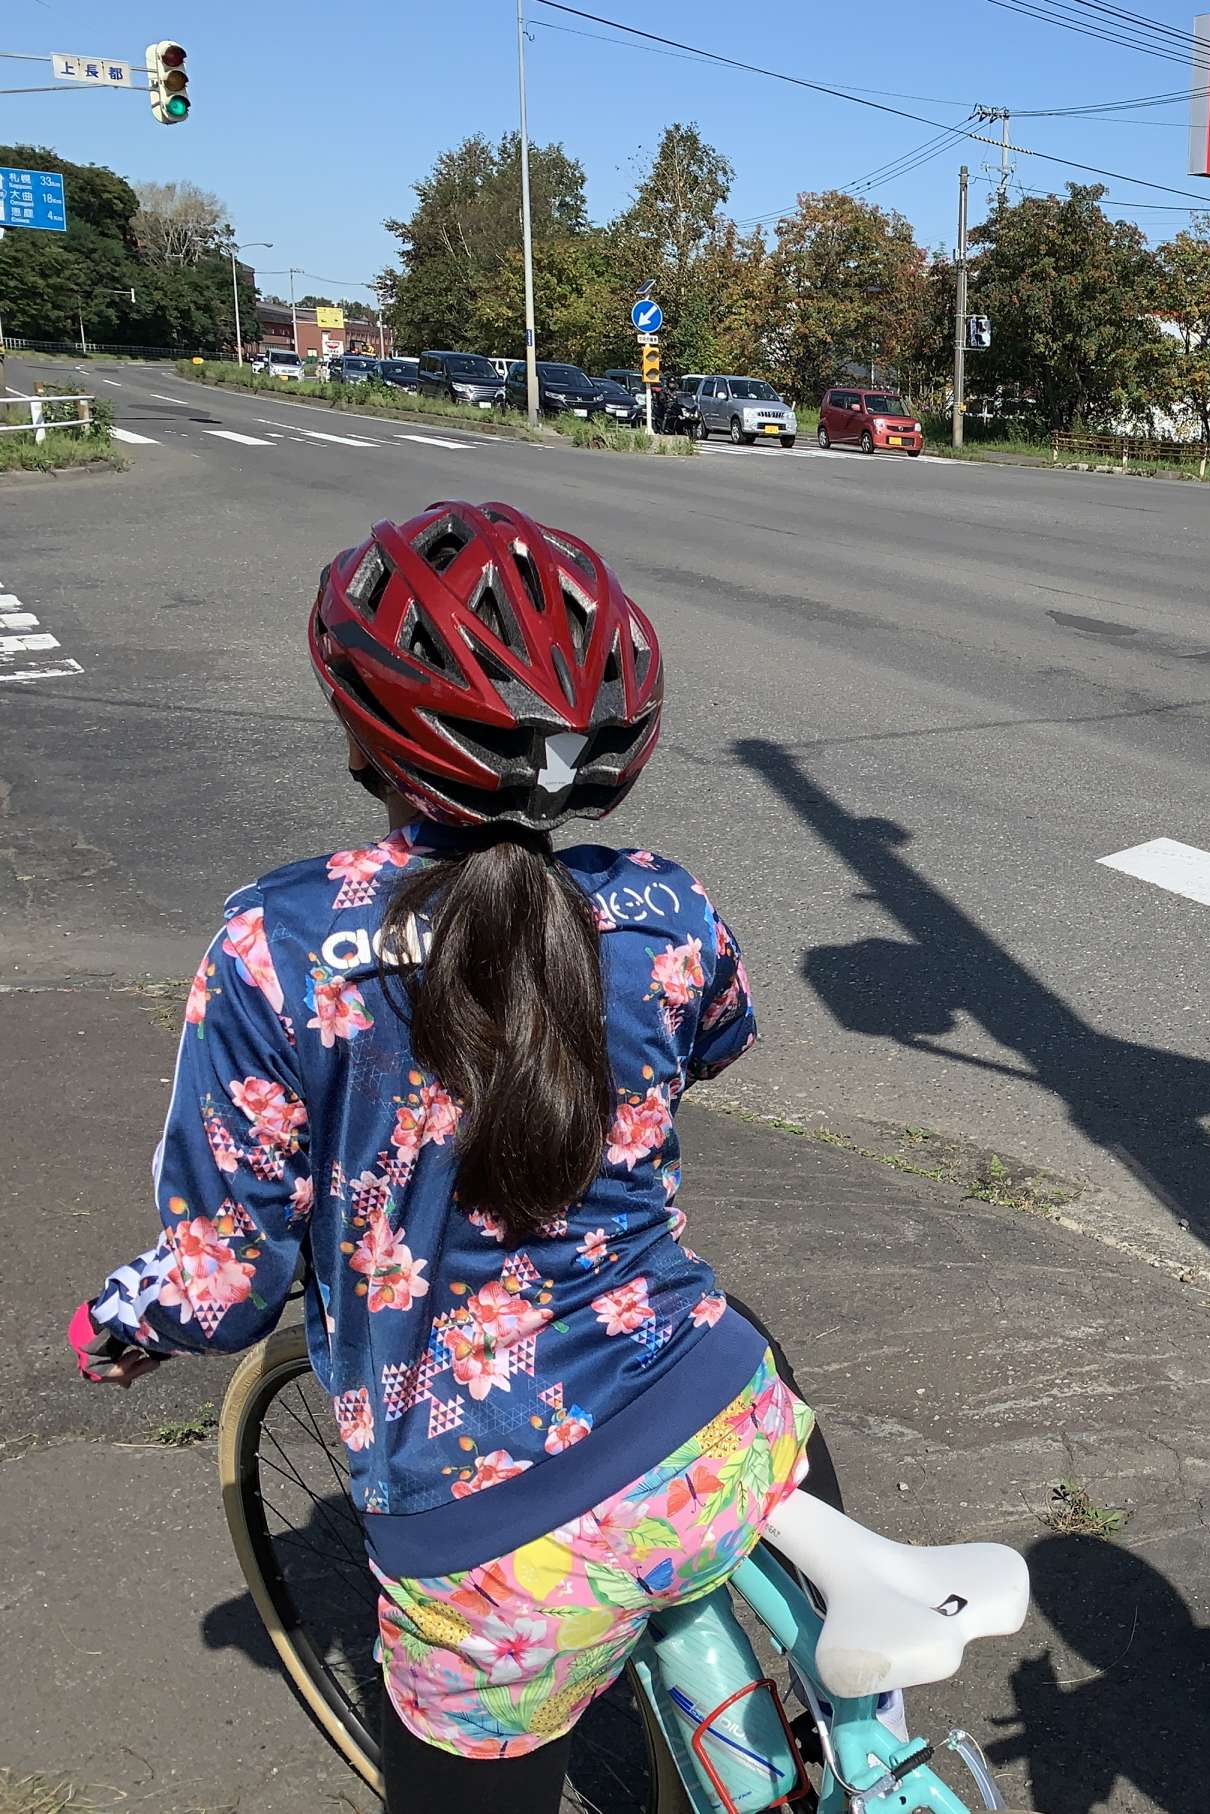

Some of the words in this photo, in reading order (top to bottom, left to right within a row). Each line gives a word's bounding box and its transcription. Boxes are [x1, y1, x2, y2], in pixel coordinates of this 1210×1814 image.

[60, 61, 123, 81] 上長都
[10, 190, 33, 200] 大曲
